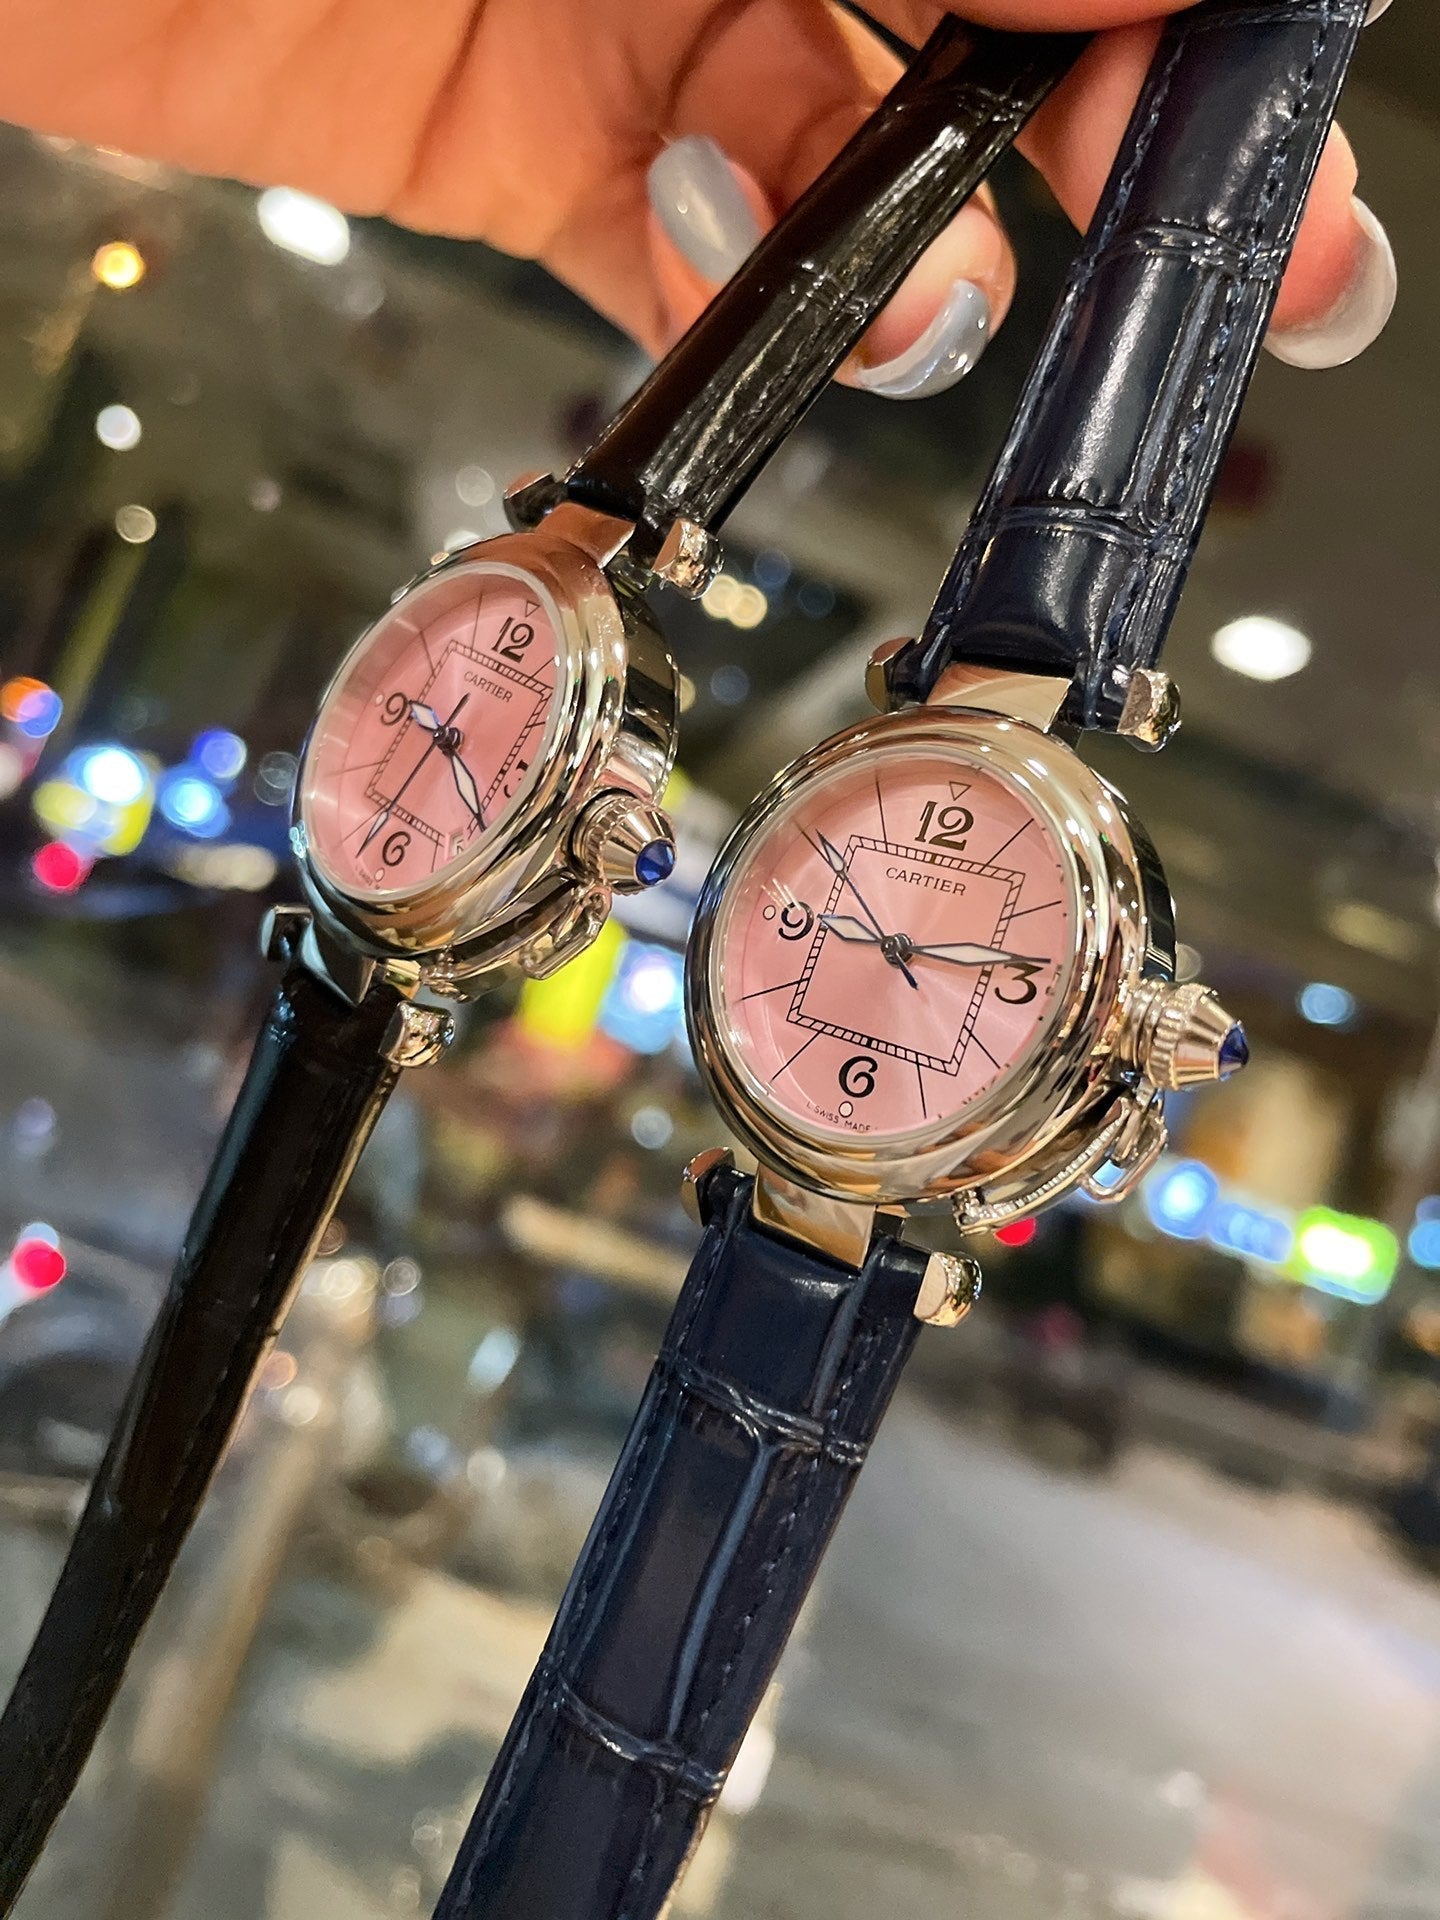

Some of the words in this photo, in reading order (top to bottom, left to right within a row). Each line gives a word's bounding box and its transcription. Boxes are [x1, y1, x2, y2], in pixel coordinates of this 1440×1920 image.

[491, 616, 534, 664] 12
[463, 671, 513, 702] CARTIER
[380, 692, 408, 726] 9
[914, 801, 974, 851] 12
[382, 831, 411, 867] 6
[886, 867, 967, 896] CARTIER
[778, 901, 814, 940] 9
[994, 964, 1044, 1004] 3
[838, 1055, 878, 1098] 6
[813, 1105, 840, 1124] SWISS
